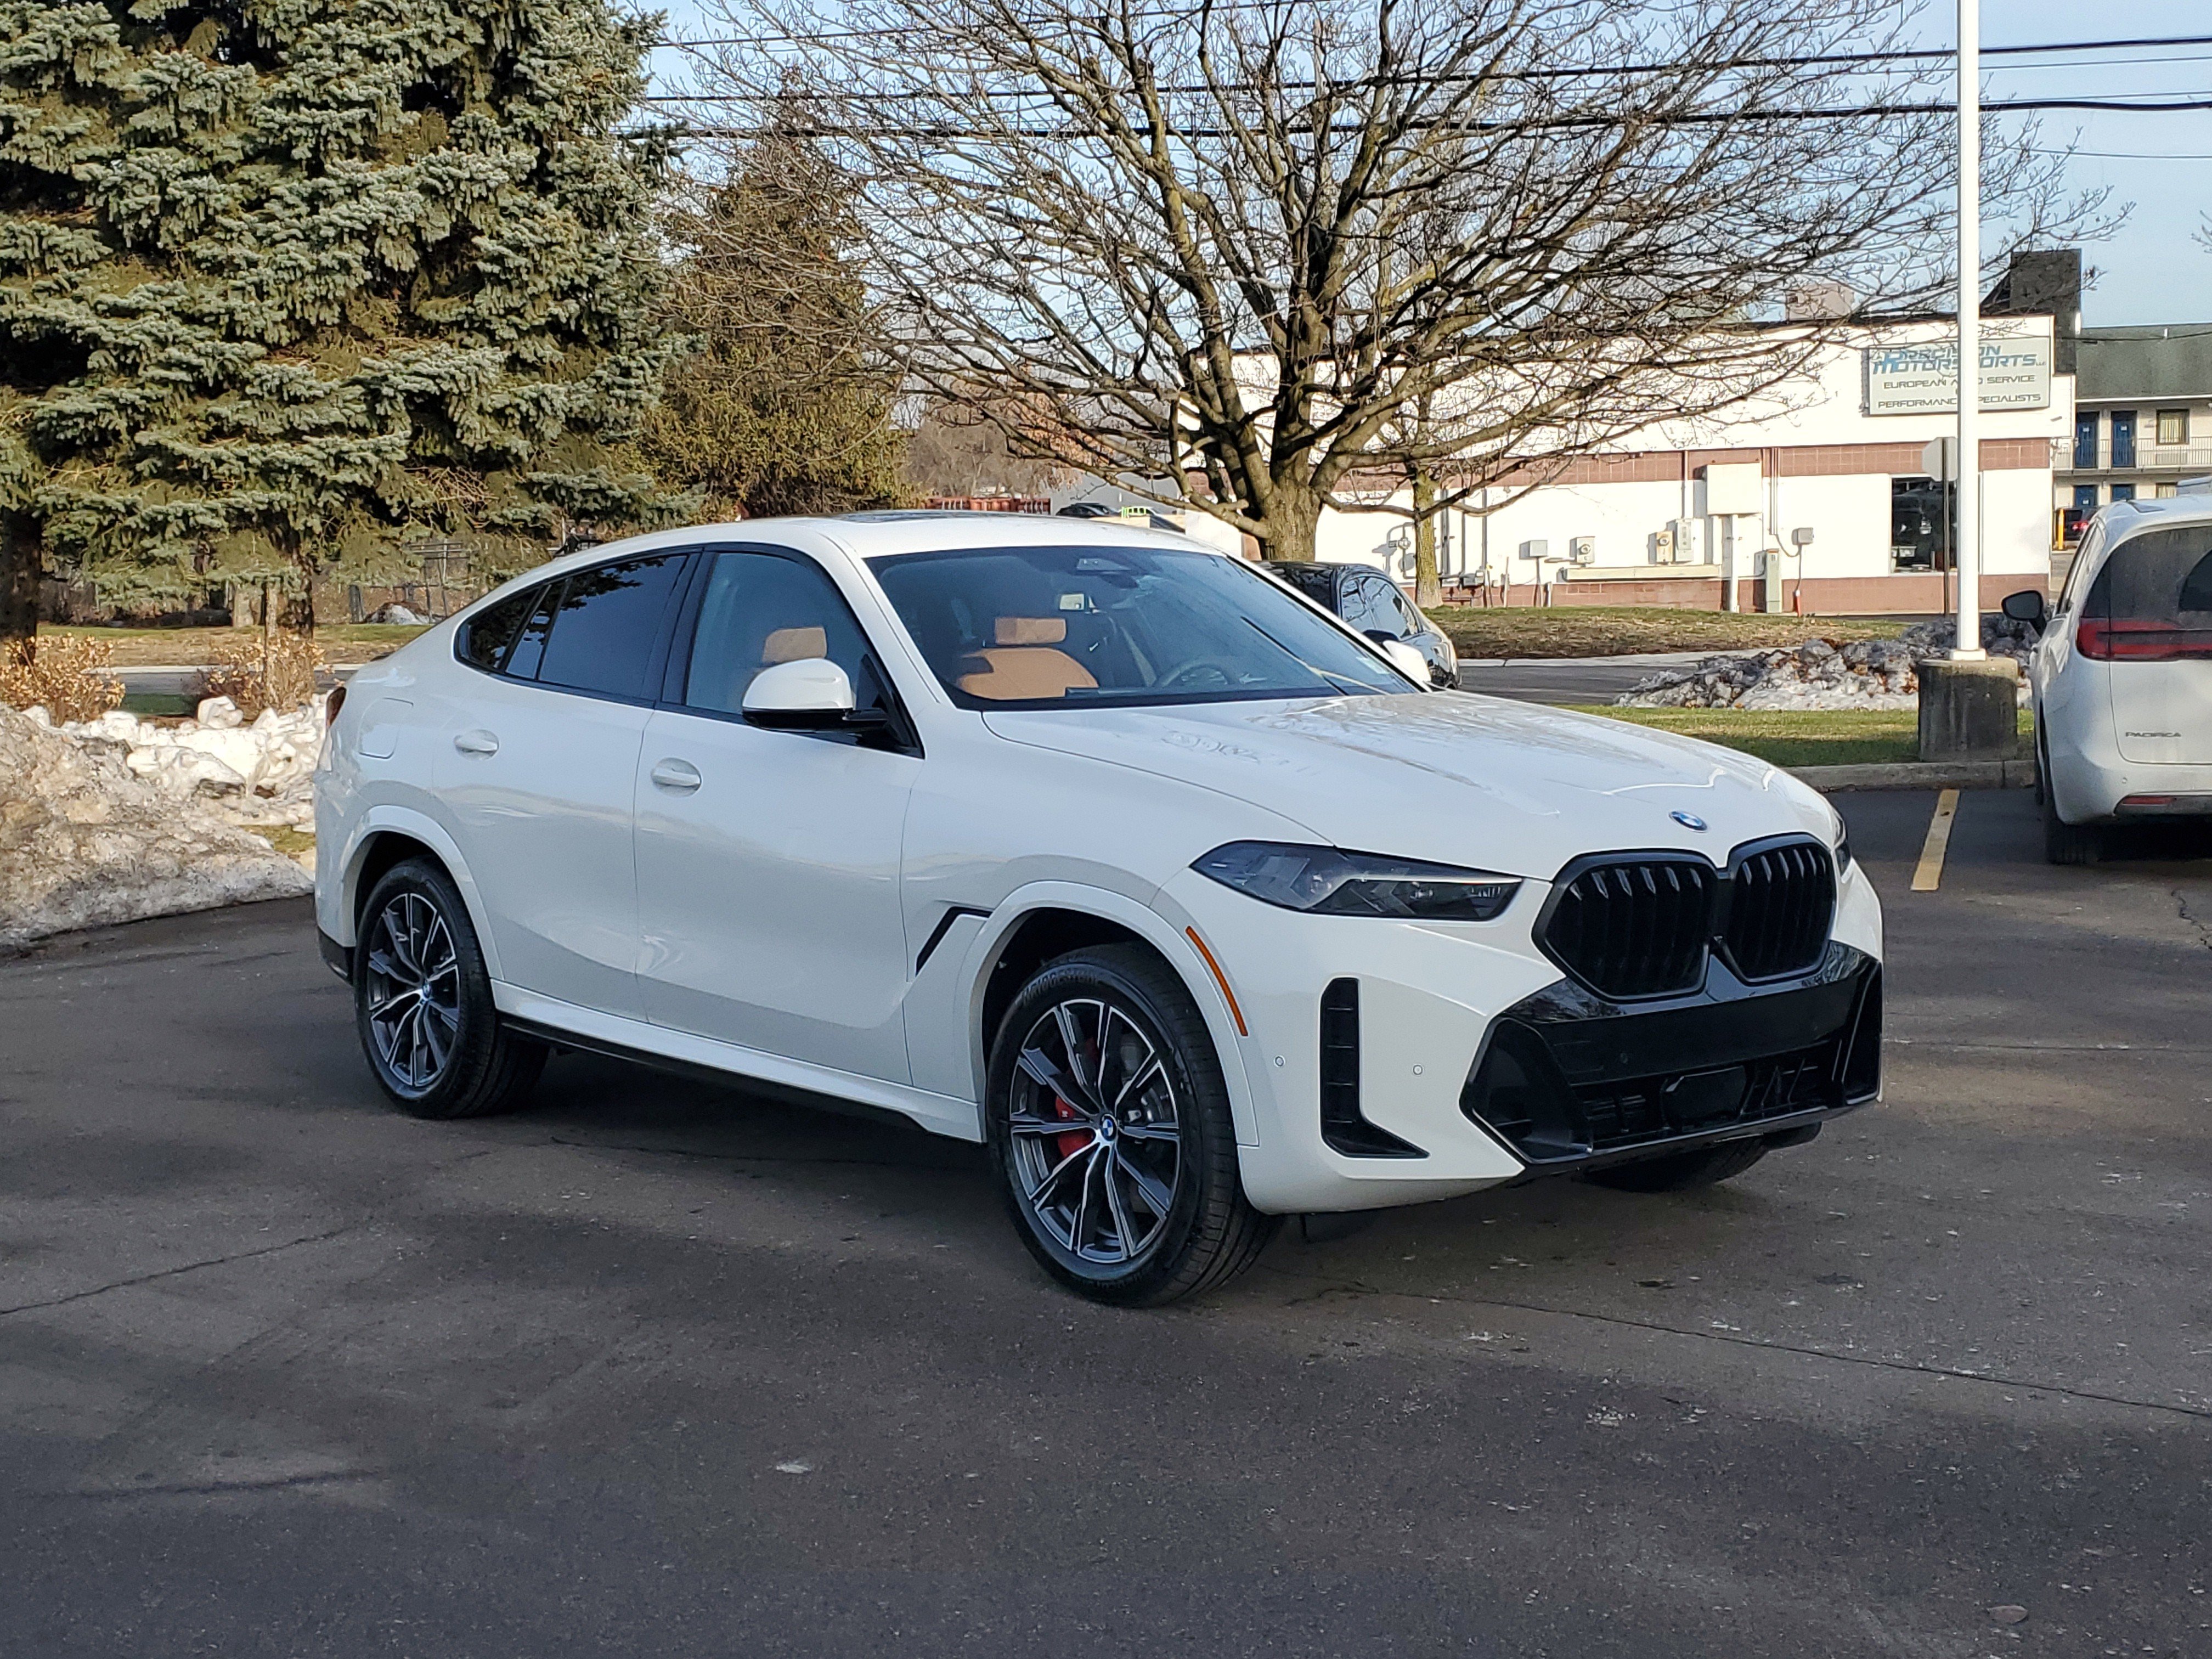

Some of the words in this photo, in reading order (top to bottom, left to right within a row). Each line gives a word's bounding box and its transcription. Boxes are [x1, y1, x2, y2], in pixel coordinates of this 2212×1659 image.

[1872, 354, 2036, 374] MOTORORTS
[1884, 379, 1946, 389] EUROPEAN
[1987, 375, 2035, 383] SERVICE
[1878, 398, 1958, 408] PERFORMANC
[1978, 394, 2041, 403] PECIALISTS
